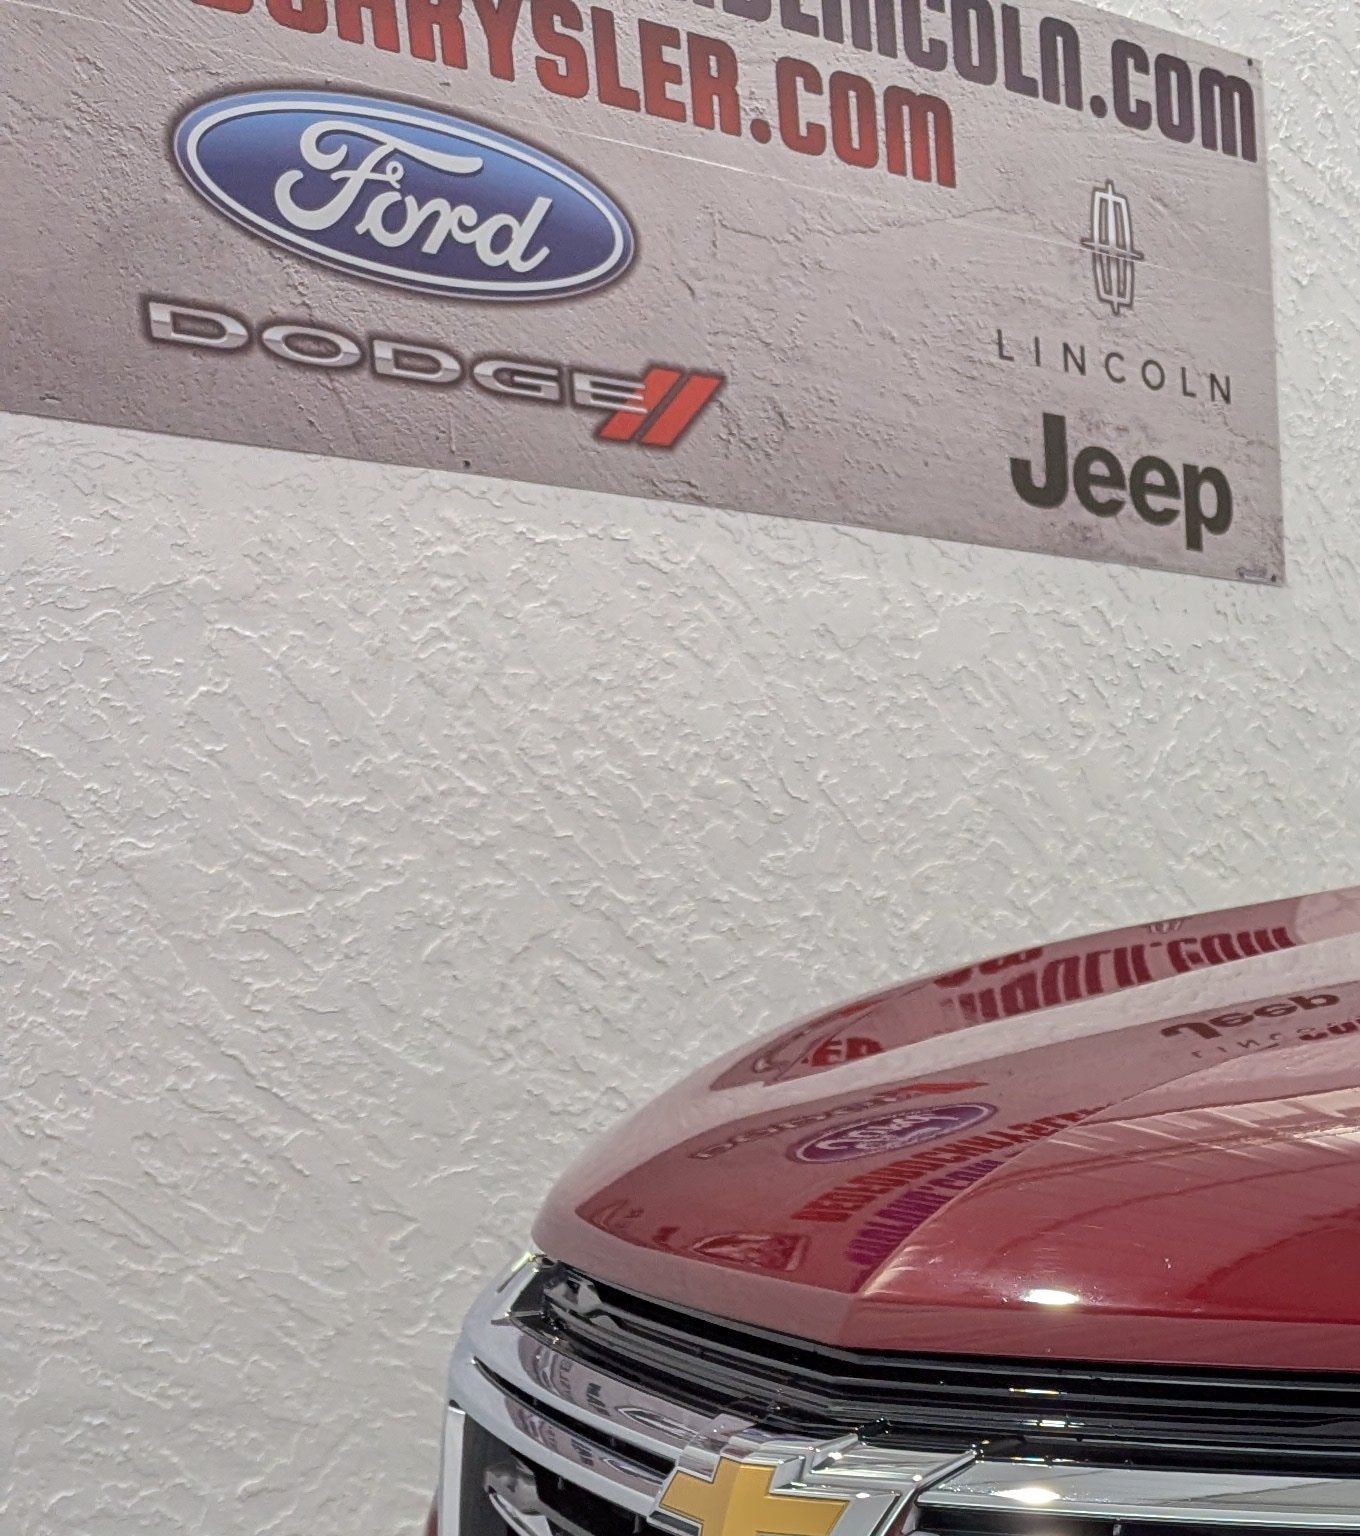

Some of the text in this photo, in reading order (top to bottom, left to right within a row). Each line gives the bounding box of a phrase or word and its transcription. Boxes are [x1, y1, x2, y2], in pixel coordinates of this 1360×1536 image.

[190, 0, 957, 188] RYSLER.COM
[693, 0, 1257, 163] NCOLN.COM
[273, 119, 554, 273] Ford
[147, 301, 648, 415] DODGE
[997, 328, 1231, 404] LINCOLN
[1009, 411, 1233, 552] Jeep
